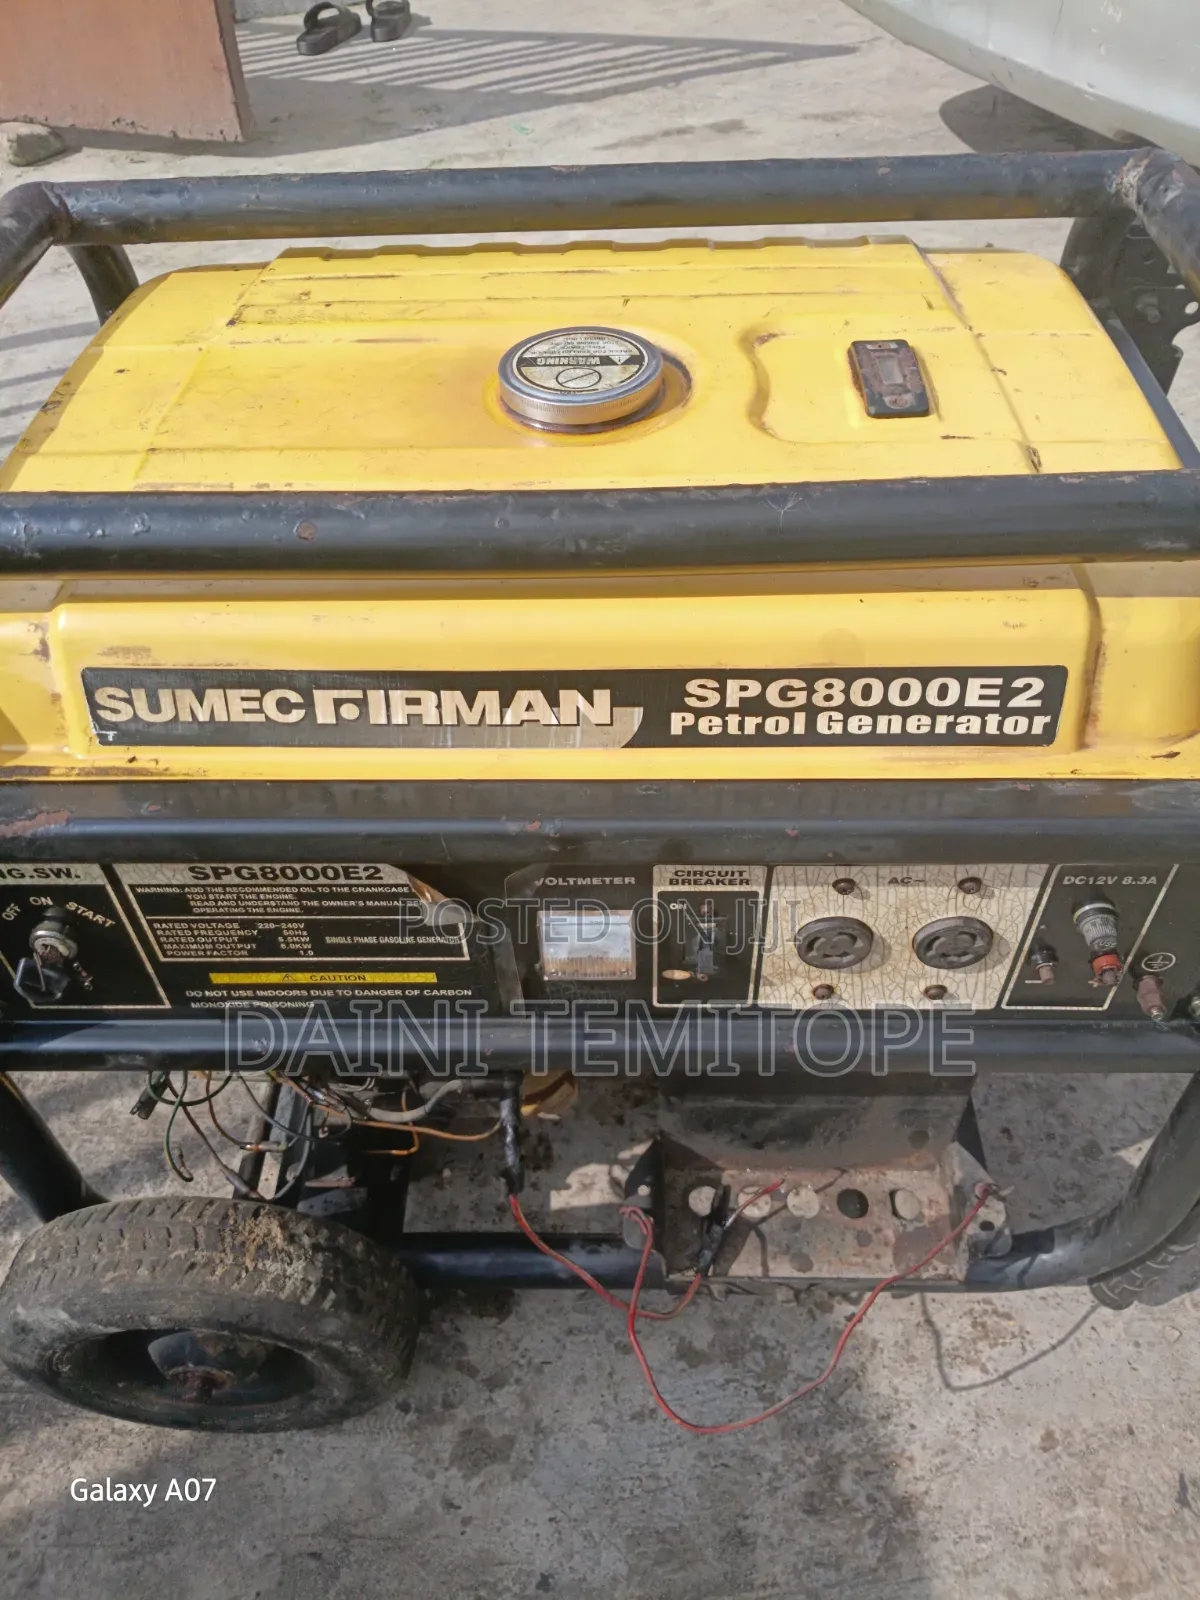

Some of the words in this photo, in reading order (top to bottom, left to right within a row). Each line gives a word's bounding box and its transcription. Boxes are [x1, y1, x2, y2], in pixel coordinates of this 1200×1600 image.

[536, 356, 601, 365] WARNING
[684, 677, 1045, 708] SPG8000E2
[94, 687, 305, 723] SUMEC
[670, 712, 807, 736] Petrol
[816, 711, 1051, 736] Generator
[188, 865, 384, 881] SPG8000E2
[673, 870, 747, 878] CIRCUIT
[534, 876, 636, 886] VOLTMETER
[668, 877, 750, 886] BREAKER
[1062, 875, 1119, 885] DC12V
[1122, 875, 1157, 885] 8.3A
[29, 896, 54, 906] ON
[1, 903, 21, 920] OFF
[66, 901, 115, 927] START
